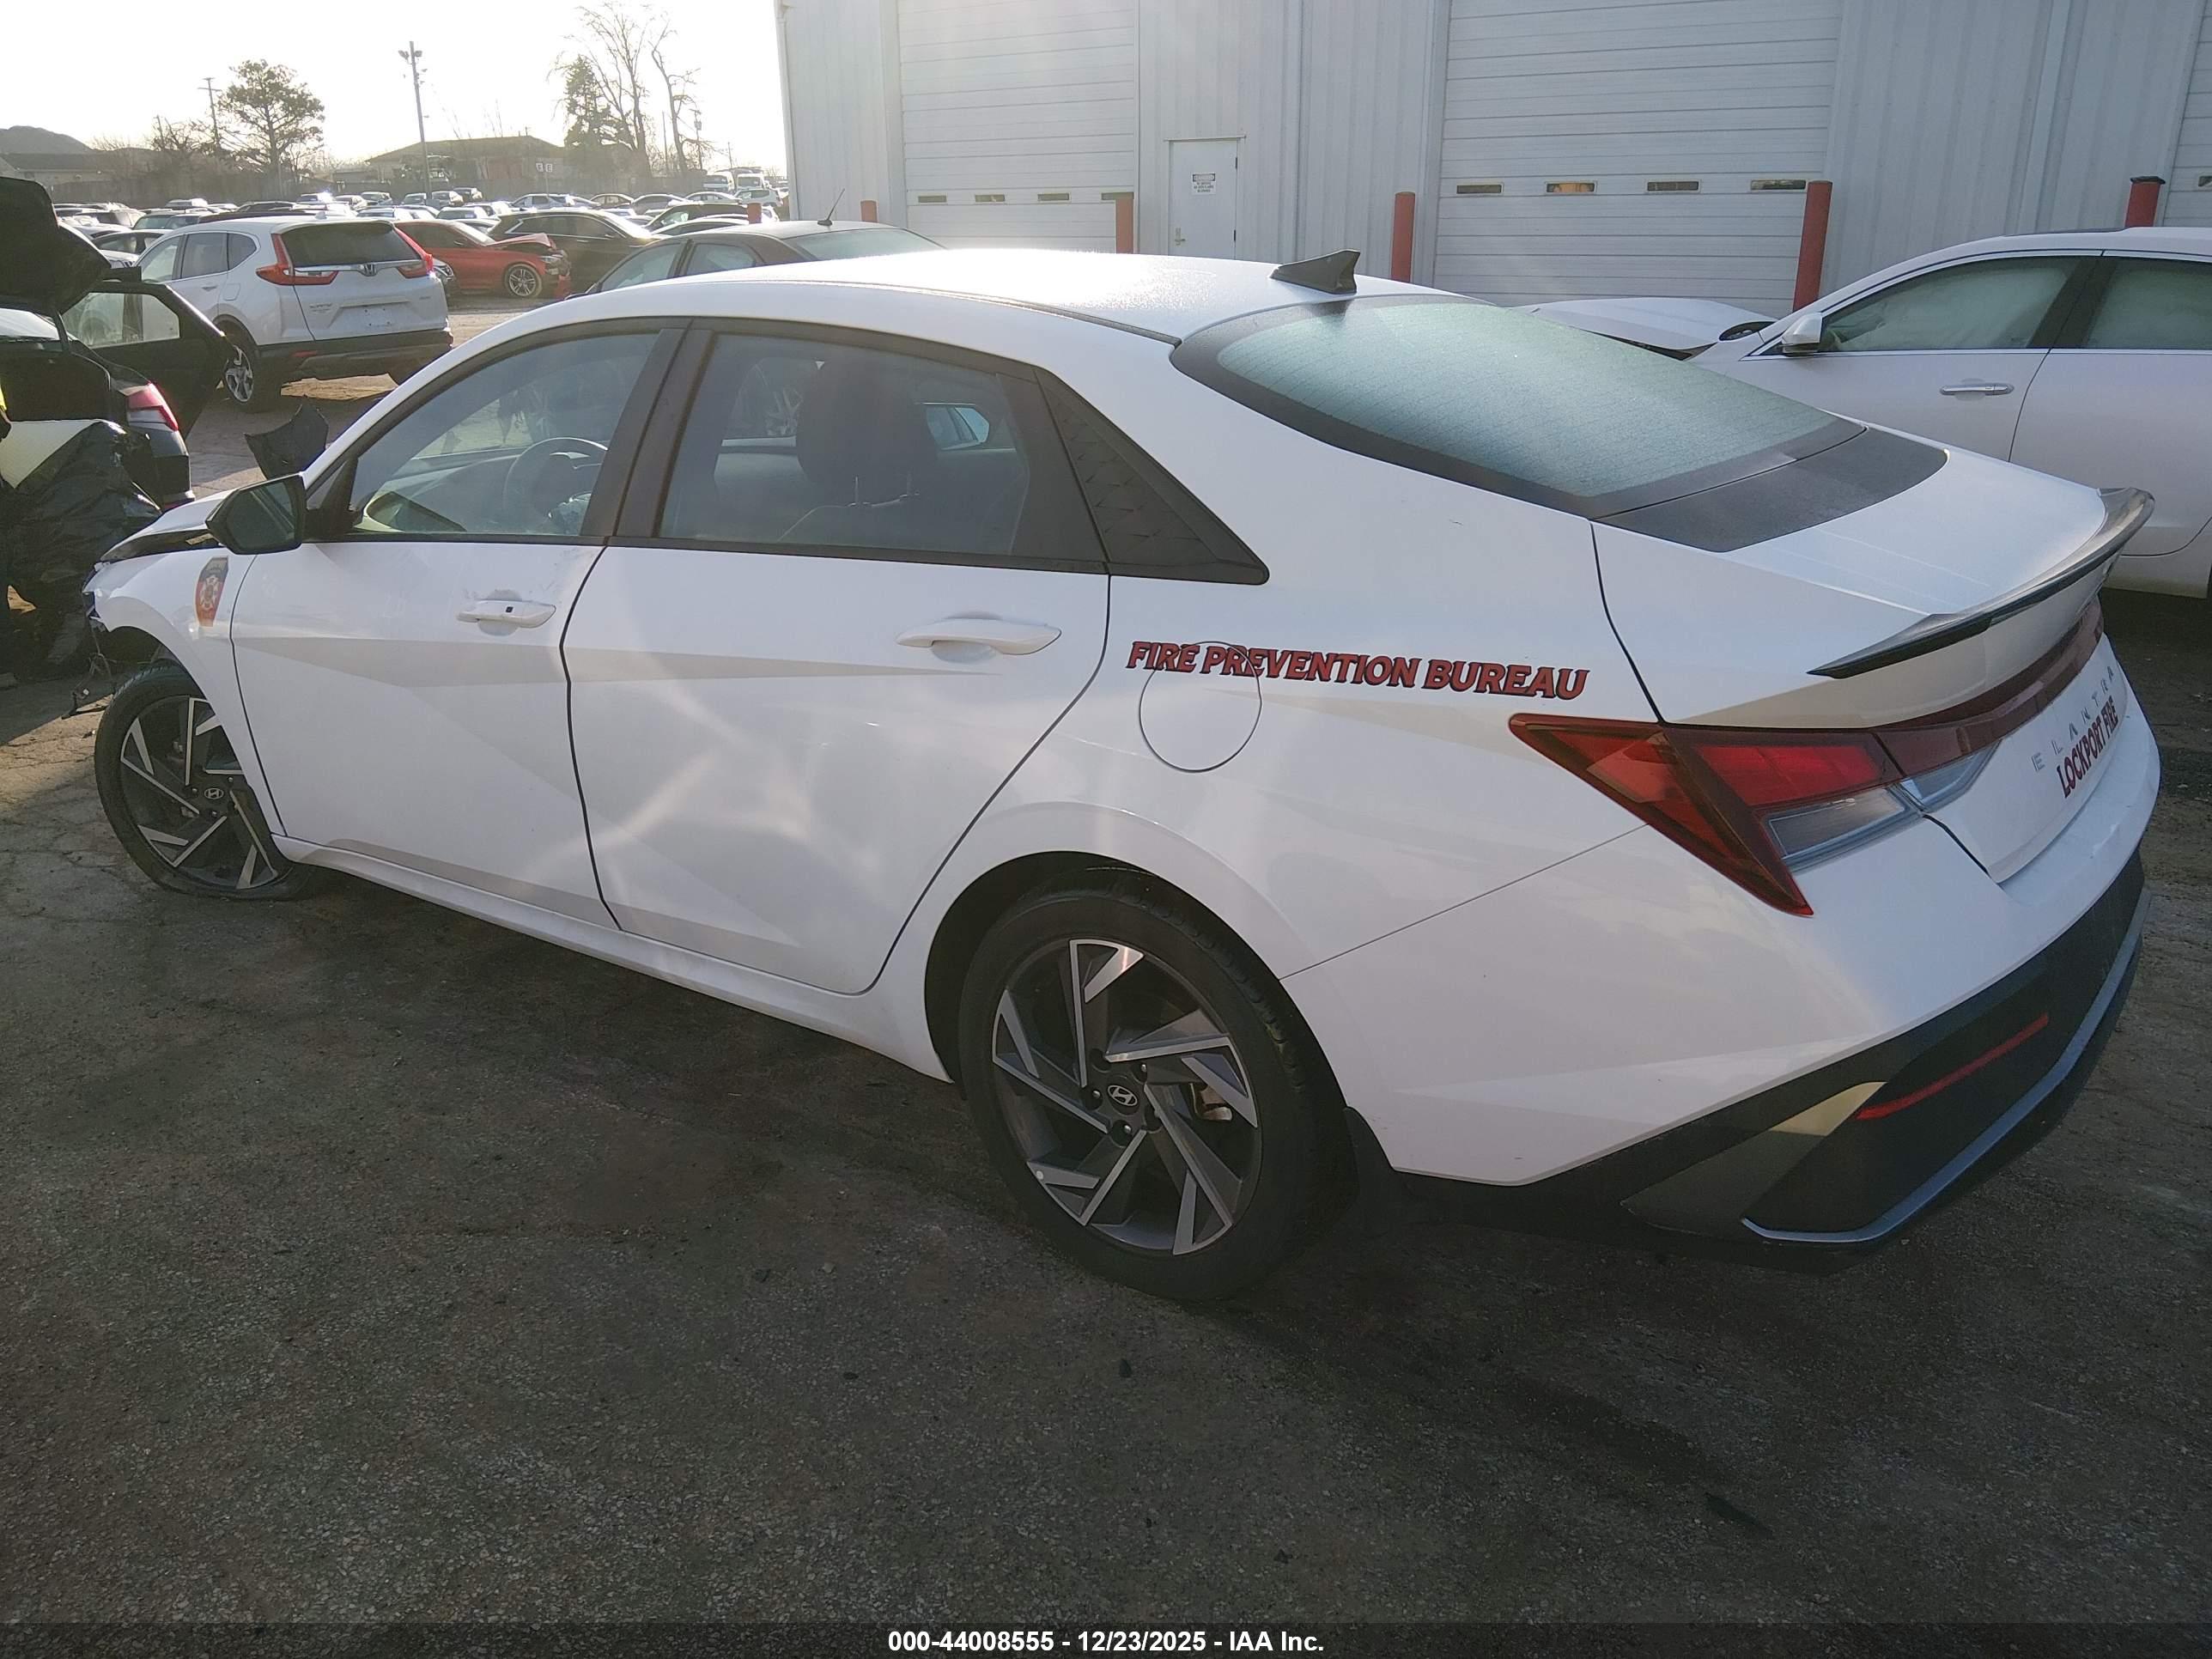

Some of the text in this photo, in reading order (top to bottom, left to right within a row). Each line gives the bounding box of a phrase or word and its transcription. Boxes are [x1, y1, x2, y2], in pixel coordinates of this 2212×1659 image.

[1126, 641, 1589, 701] FIRE PREVENTION BUREAU
[2031, 665, 2114, 772] ELANTRA
[2056, 696, 2118, 799] LOCKPORT FIRE
